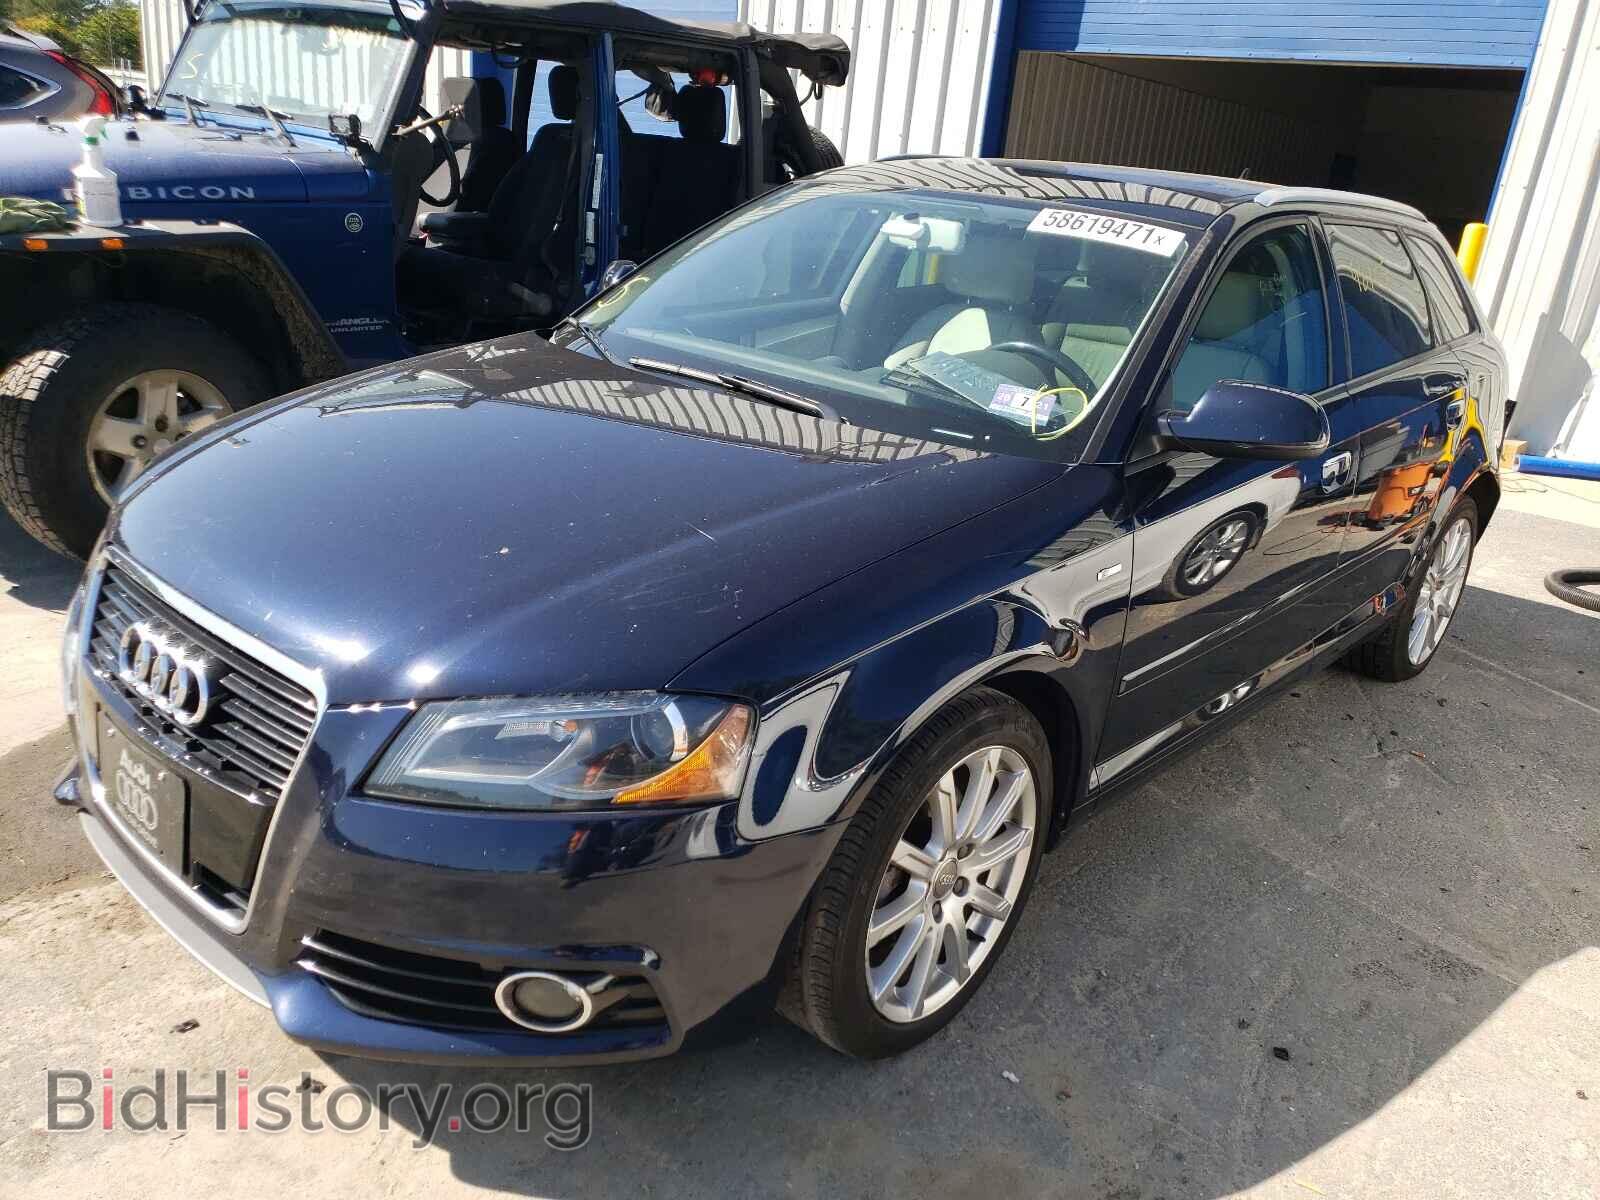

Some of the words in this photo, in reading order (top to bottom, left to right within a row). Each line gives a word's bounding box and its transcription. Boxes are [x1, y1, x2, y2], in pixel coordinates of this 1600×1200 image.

[63, 185, 256, 199] BICON
[1043, 210, 1155, 244] 58619471
[1020, 396, 1031, 407] 7
